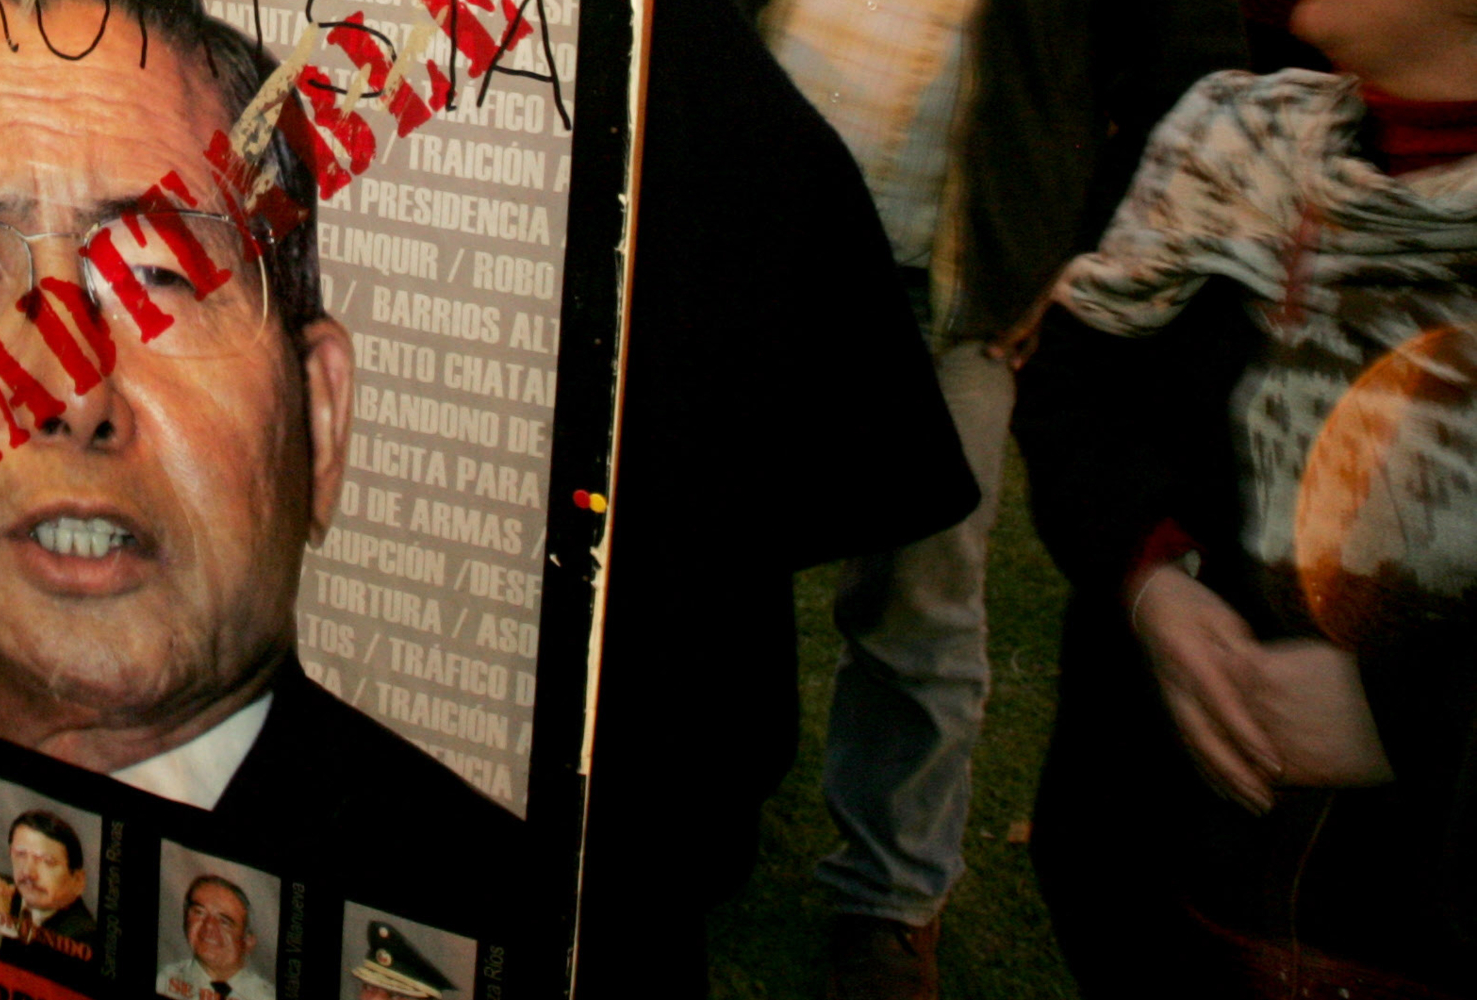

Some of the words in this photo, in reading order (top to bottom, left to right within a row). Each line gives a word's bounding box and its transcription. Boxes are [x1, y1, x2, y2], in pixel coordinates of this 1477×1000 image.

[408, 132, 546, 193] TRAICIÓN
[359, 178, 550, 247] PRESIDENCIA
[472, 251, 555, 300] ROBO
[372, 285, 500, 345] BARRIOS
[506, 414, 547, 459] DE
[348, 431, 448, 489] ILÍCITA
[455, 456, 541, 509] PARA
[366, 486, 403, 528] DE
[409, 498, 523, 556] ARMAS
[309, 526, 446, 587] RUPCIÓN
[314, 569, 442, 636] TORTURA
[475, 612, 538, 659] ASO
[388, 636, 508, 701] TRÁFICO
[375, 681, 509, 750] TRAICIÓN
